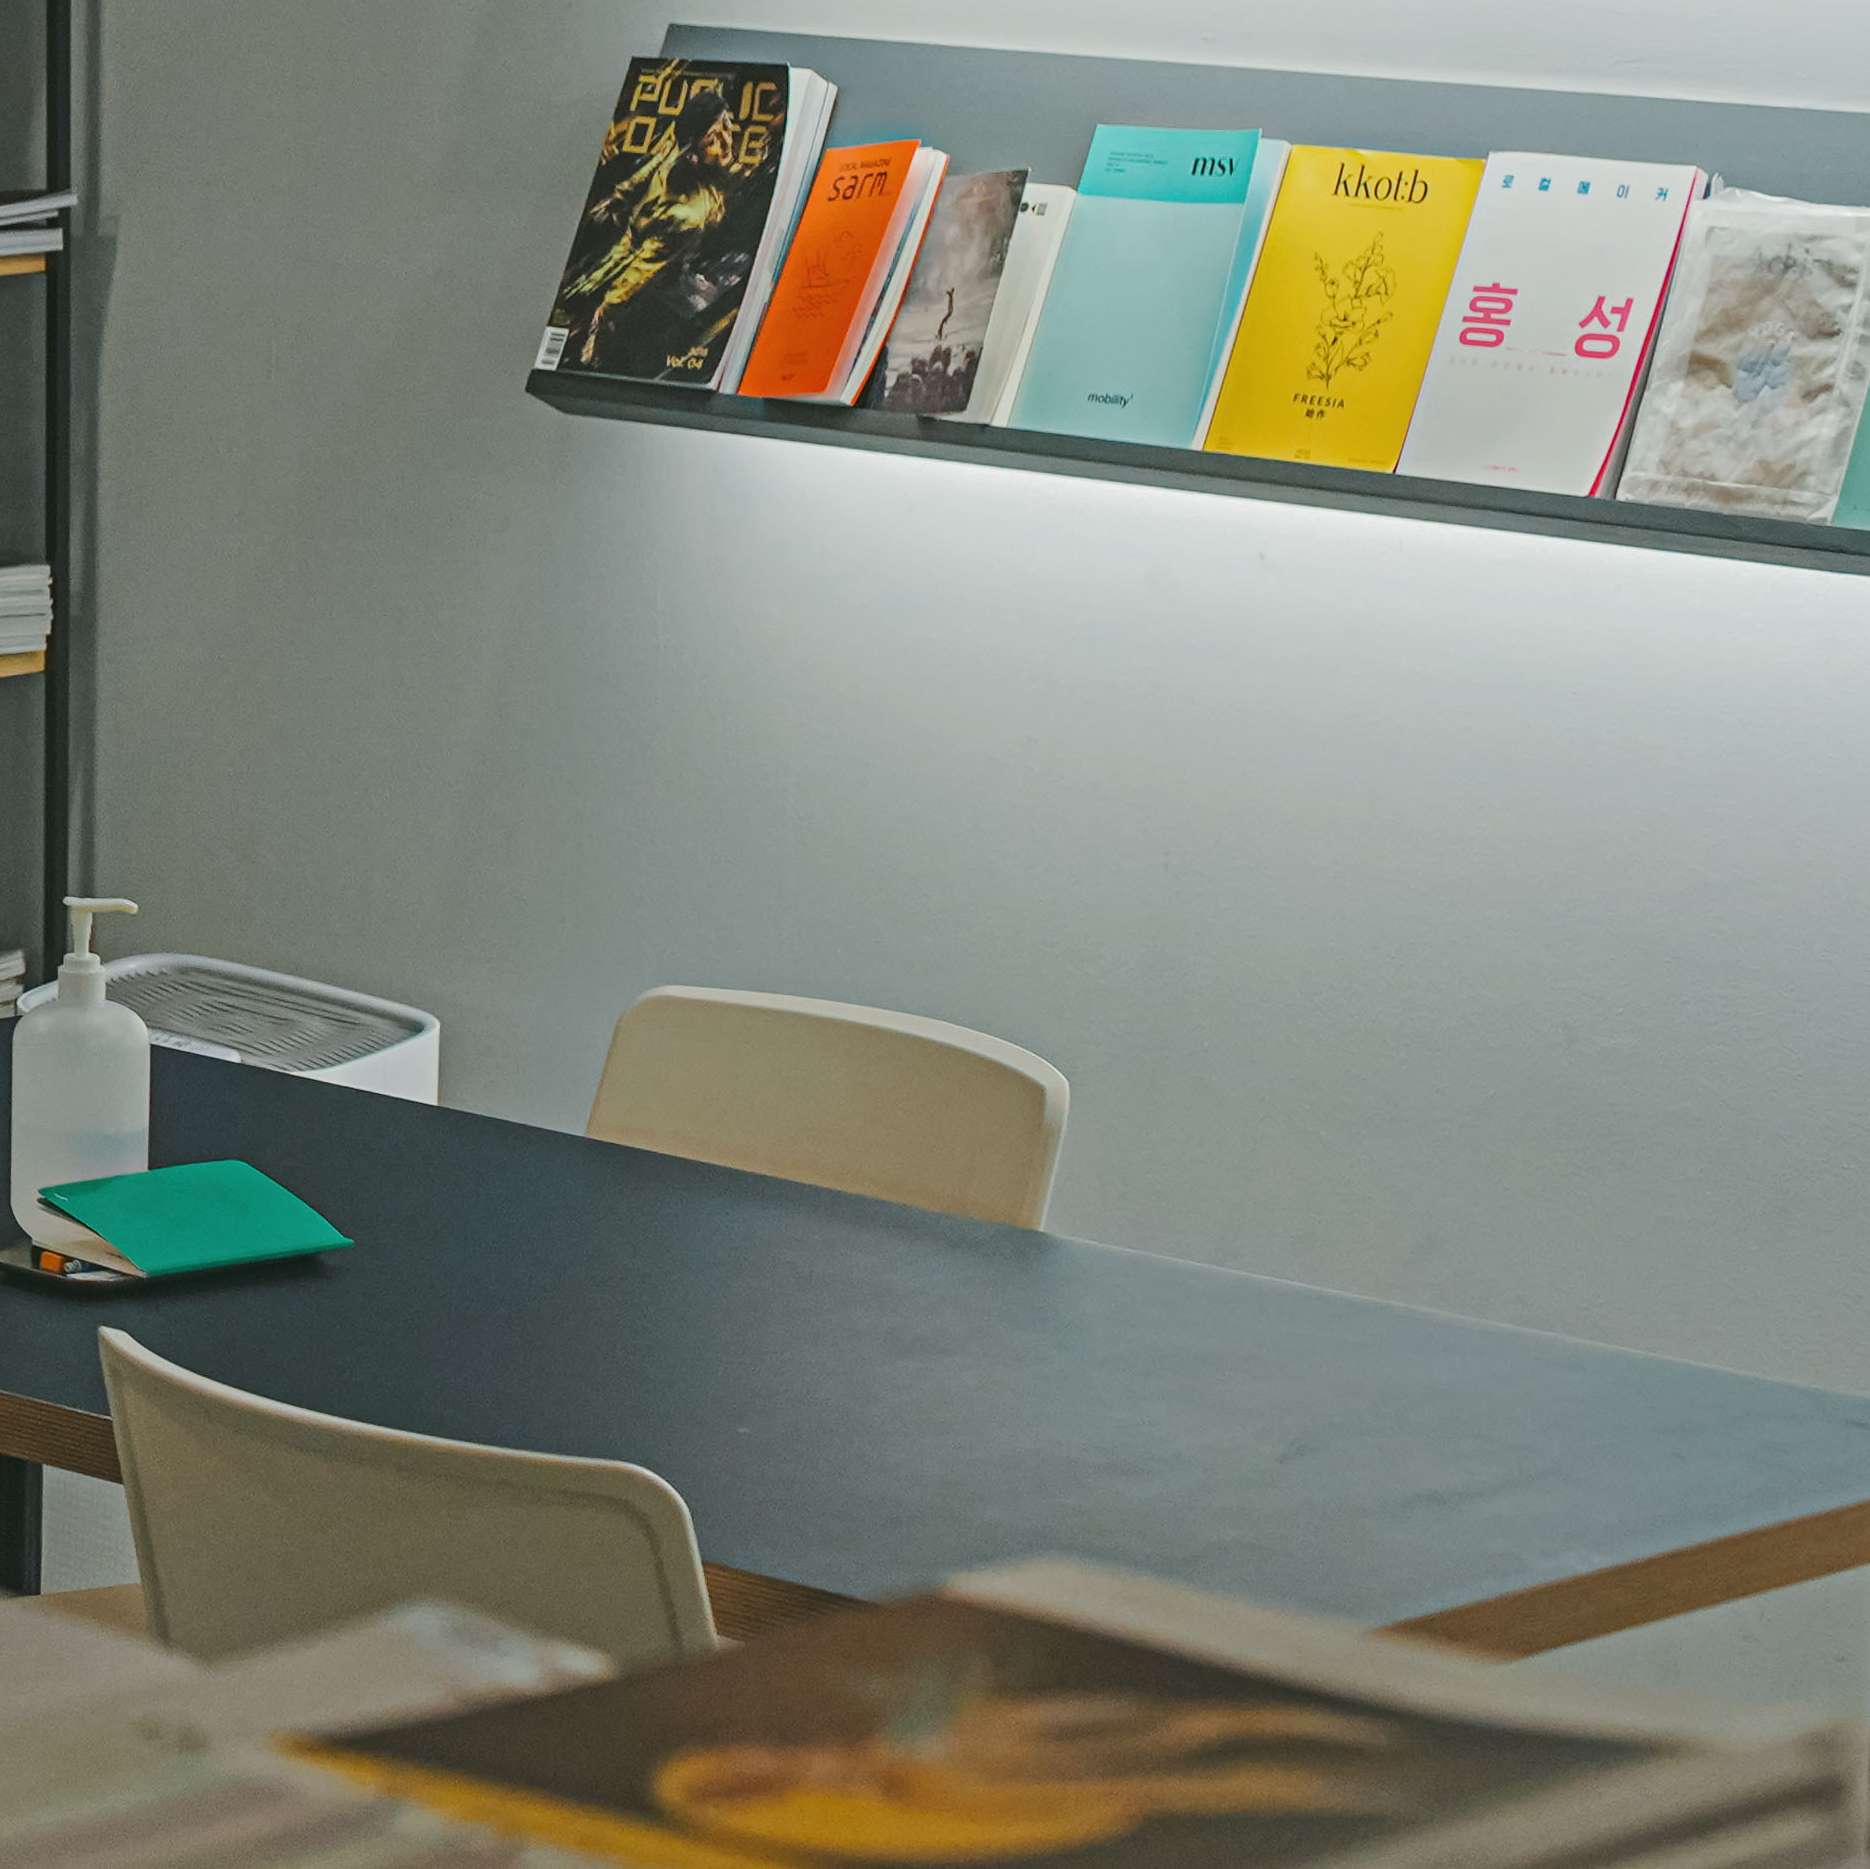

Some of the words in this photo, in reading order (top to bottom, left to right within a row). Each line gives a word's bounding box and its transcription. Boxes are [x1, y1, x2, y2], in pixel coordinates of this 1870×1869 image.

[1191, 157, 1240, 177] msv
[828, 170, 888, 202] sarm
[1333, 162, 1429, 205] kkot:b
[1293, 392, 1345, 409] FREESIA
